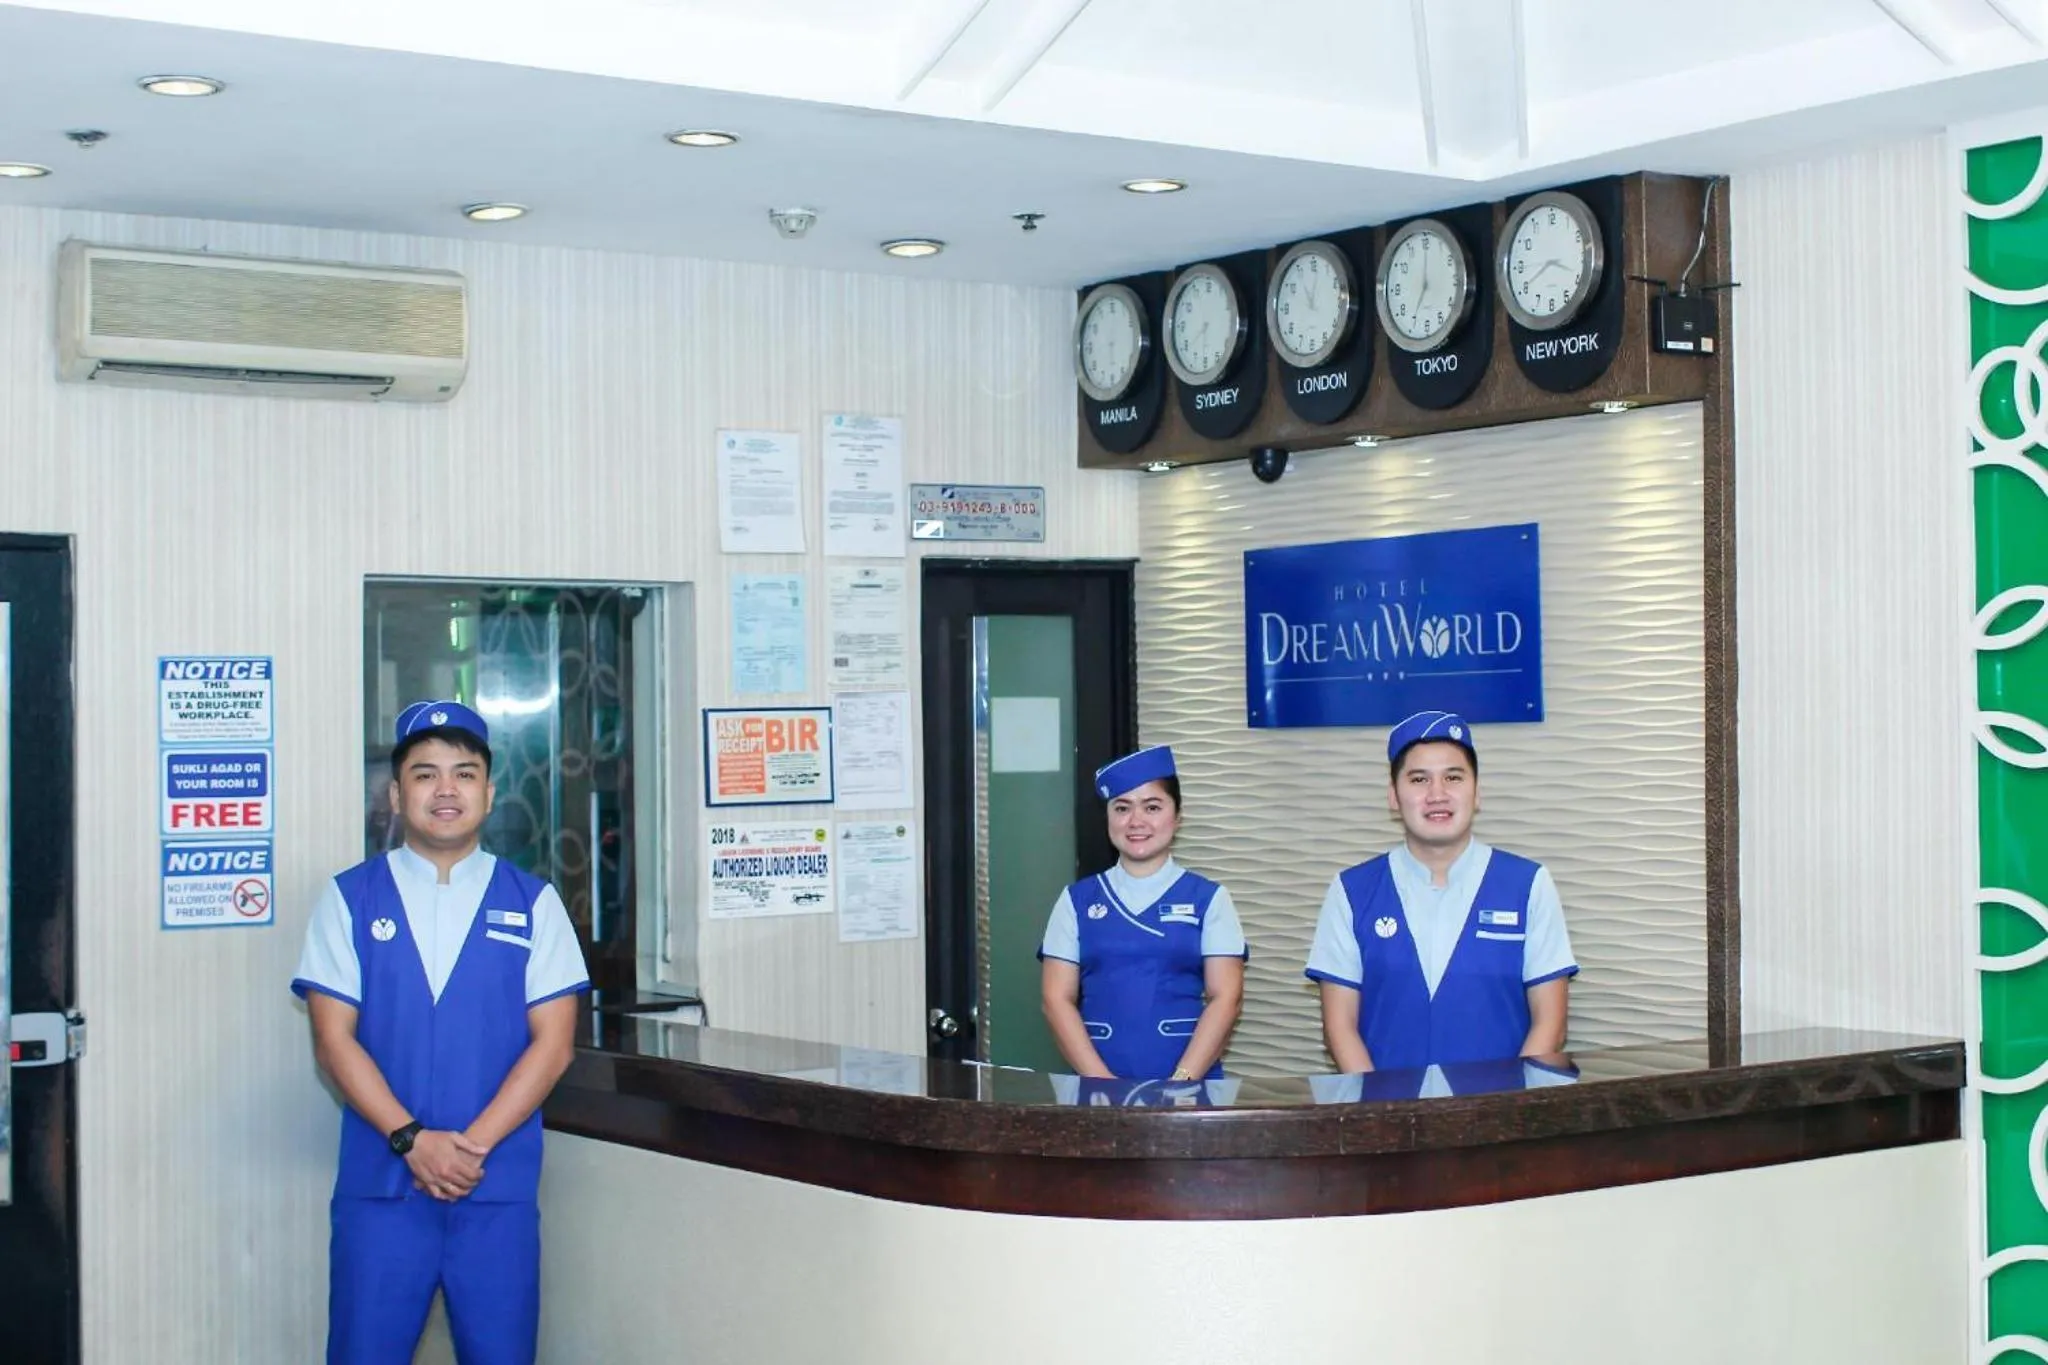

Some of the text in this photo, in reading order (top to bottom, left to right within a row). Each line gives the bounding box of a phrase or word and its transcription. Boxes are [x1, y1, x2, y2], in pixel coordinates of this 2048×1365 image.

[1526, 333, 1600, 361] NEW YORK
[1414, 354, 1458, 376] TOKYO
[1298, 371, 1347, 395] LONDON
[1195, 387, 1239, 410] SYDNEY
[1100, 405, 1138, 425] MANILA
[1334, 578, 1429, 601] HOTEL
[164, 661, 268, 680] NOTICE
[203, 681, 230, 689] THIS
[167, 690, 265, 700] ESTABLISHMENT
[170, 700, 262, 710] IS A DRUG-FREE
[717, 719, 741, 737] ASK
[766, 718, 819, 753] BIR
[718, 738, 764, 753] RECEIPT
[171, 762, 262, 774] SUKLI AGAD OR
[175, 778, 259, 790] YOUR ROOM IS
[171, 802, 262, 828] FREE
[712, 828, 735, 844] 2018
[168, 851, 268, 872] NOTICE
[712, 853, 828, 878] AUTHORIZED LIQUOR DEALER
[167, 881, 233, 893] NO FIREARMS
[168, 894, 232, 905] ALLOWED ON
[176, 907, 225, 917] PREMISES
